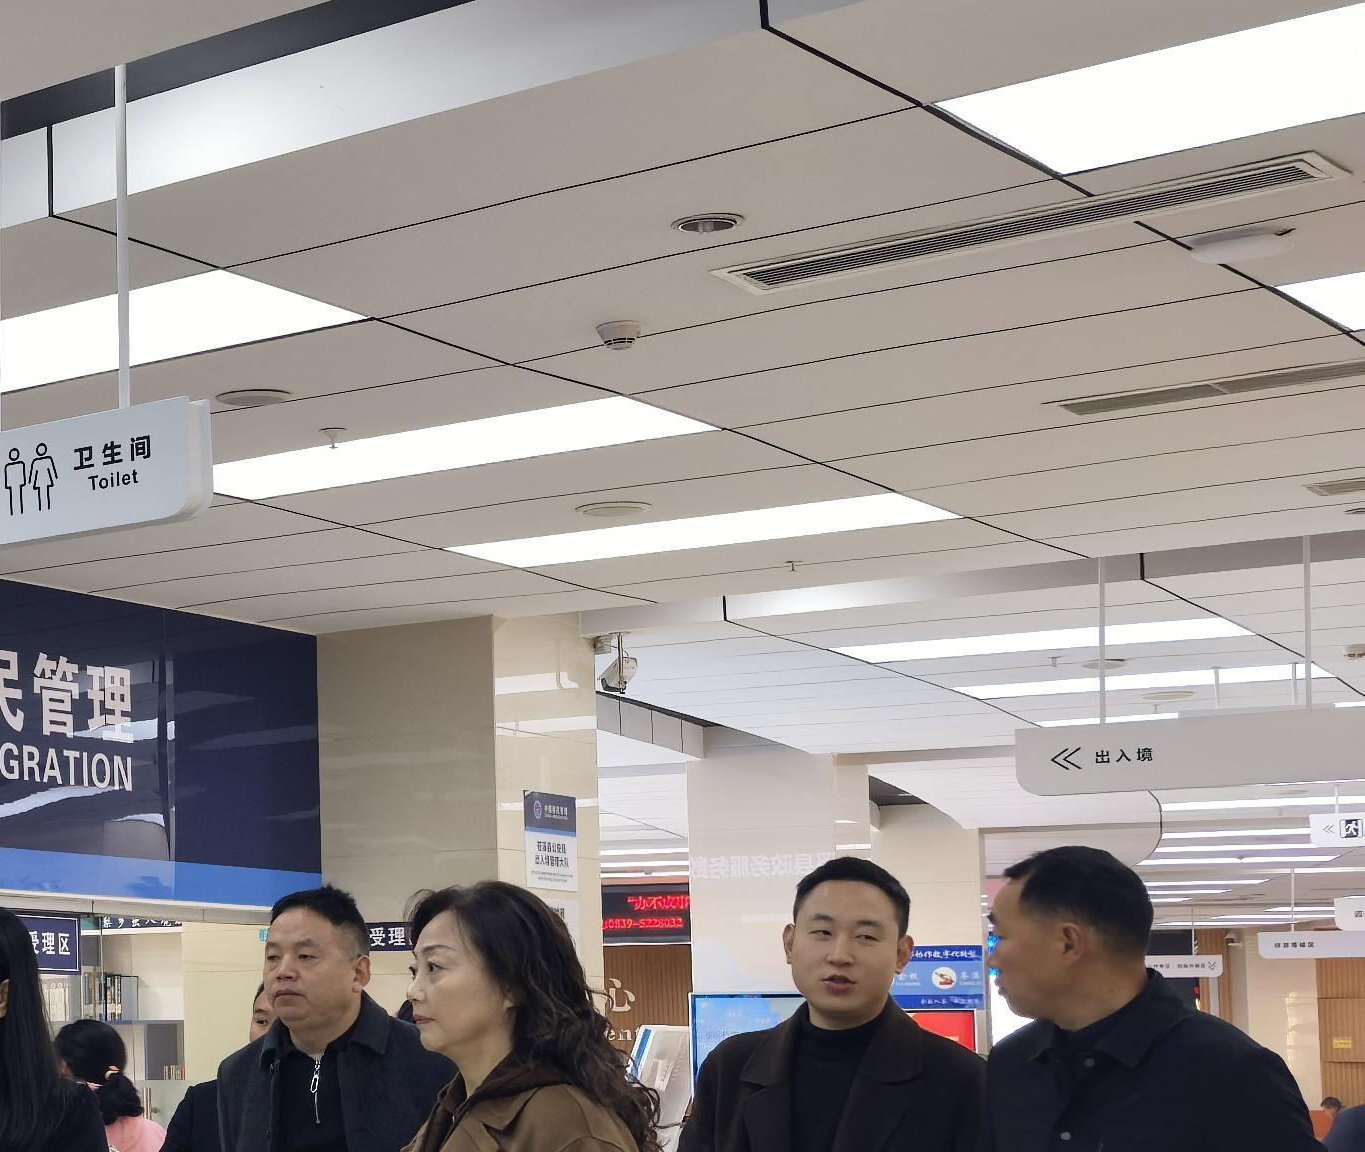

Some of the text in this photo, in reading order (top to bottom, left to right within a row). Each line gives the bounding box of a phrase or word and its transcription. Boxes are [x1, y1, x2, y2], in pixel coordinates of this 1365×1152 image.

[73, 435, 151, 471] 卫生间
[87, 468, 139, 491] Toilet
[1095, 747, 1153, 763] 出入境
[369, 926, 413, 947] 受理
